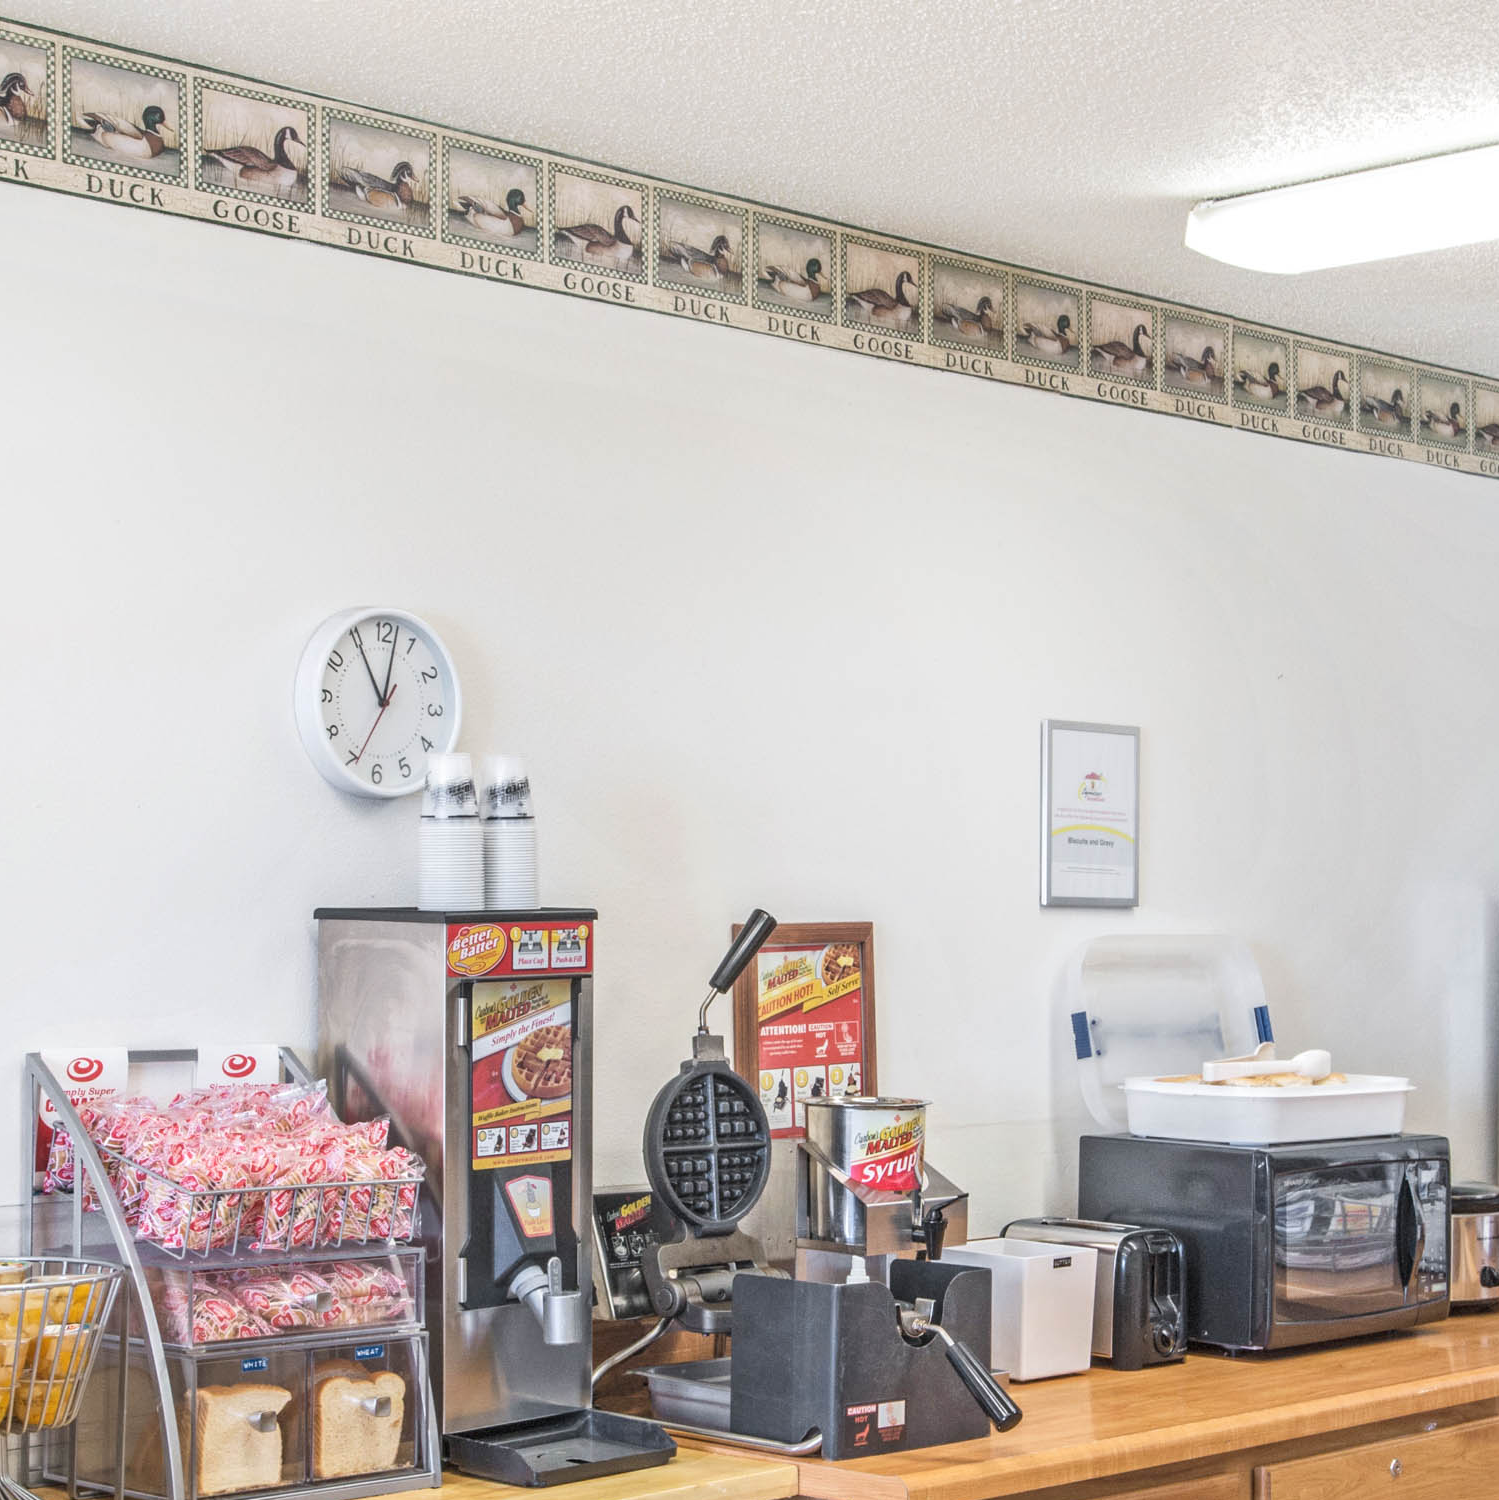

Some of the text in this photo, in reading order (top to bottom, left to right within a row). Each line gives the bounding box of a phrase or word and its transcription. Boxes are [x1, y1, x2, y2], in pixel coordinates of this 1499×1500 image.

[85, 174, 165, 207] DUCK
[213, 200, 301, 234] GOOSE
[346, 227, 416, 258] DUCK
[460, 251, 524, 281] DUCK
[563, 272, 636, 303] GOOSE
[673, 295, 731, 323] DUCK
[767, 316, 821, 342] DUCK
[853, 334, 915, 360] GOOSE
[945, 352, 994, 377] DUCK
[1024, 369, 1070, 391] DUCK
[1097, 383, 1149, 407] GOOSE
[1175, 399, 1216, 421] DUCK
[1240, 412, 1280, 434] DUCK
[1302, 425, 1347, 446] GOOSE
[1369, 438, 1404, 457] DUCK
[1426, 450, 1461, 468] DUCK
[376, 622, 393, 643] 12
[407, 638, 416, 655] 1
[327, 650, 344, 672] 10
[421, 666, 438, 684] 2
[322, 689, 333, 703] 9
[428, 704, 443, 717] 3
[421, 736, 434, 752] 4
[345, 750, 360, 766] 7
[372, 764, 383, 784] 6
[399, 757, 411, 778] 5
[452, 928, 493, 953] Better
[460, 937, 500, 960] Batter
[794, 983, 814, 1001] HOT!
[827, 978, 859, 997] Self Serve
[485, 1001, 532, 1031] MALTED
[760, 1024, 806, 1036] ATTENTION!
[88, 1088, 116, 1097] Super
[865, 1131, 913, 1155] MALTED
[862, 1152, 917, 1183] Syrup
[620, 1195, 651, 1217] GOLDEN
[357, 1347, 380, 1357] WHEAT
[243, 1360, 268, 1369] WHITE
[847, 1404, 877, 1416] CAUTION
